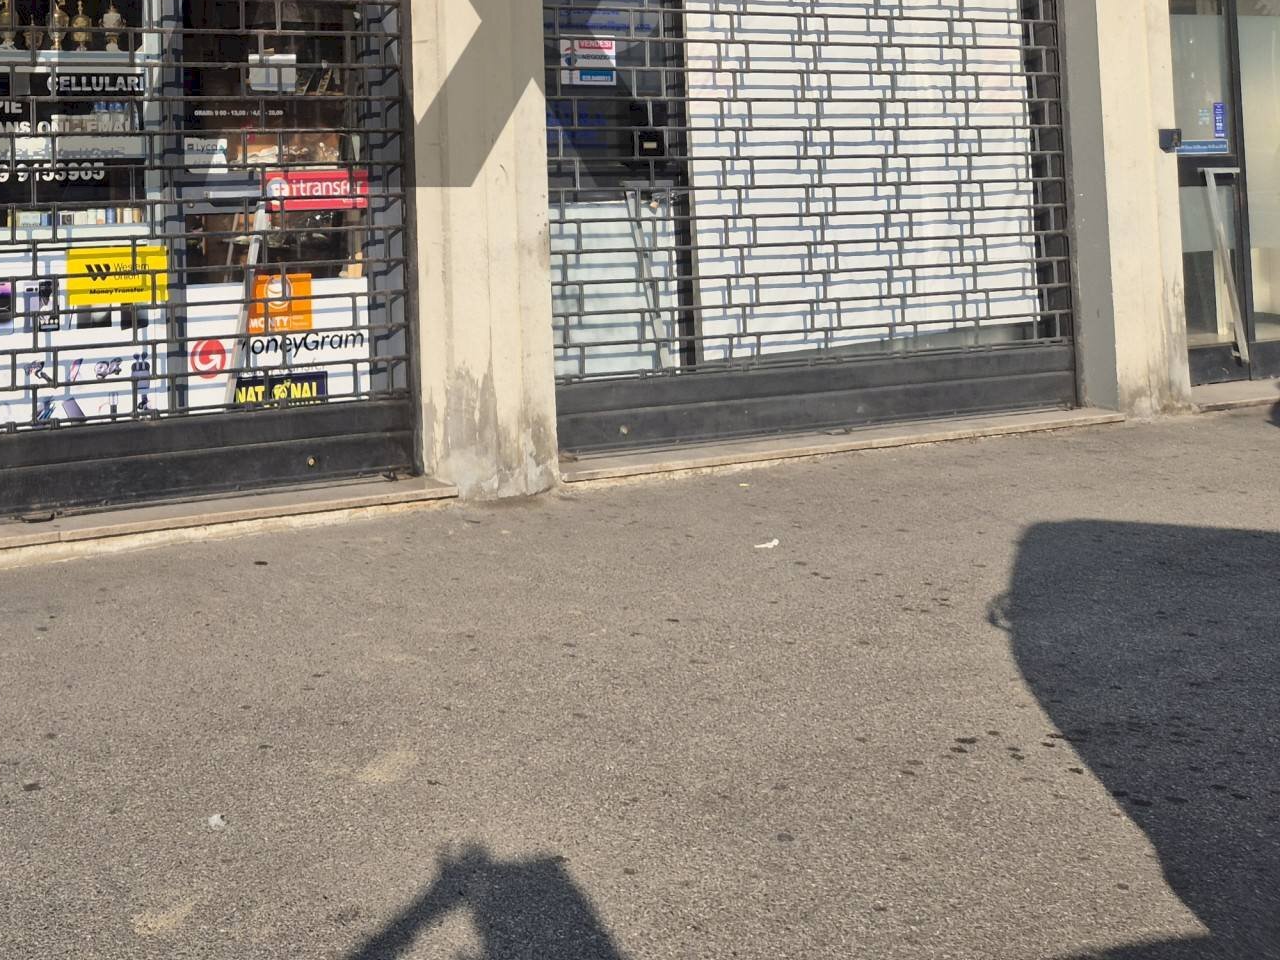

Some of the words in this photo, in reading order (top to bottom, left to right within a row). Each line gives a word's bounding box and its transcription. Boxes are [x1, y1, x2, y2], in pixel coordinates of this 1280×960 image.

[47, 75, 144, 91] CELLULARI
[89, 287, 114, 295] Money
[114, 286, 144, 294] Transfer
[241, 332, 364, 358] oneyGram
